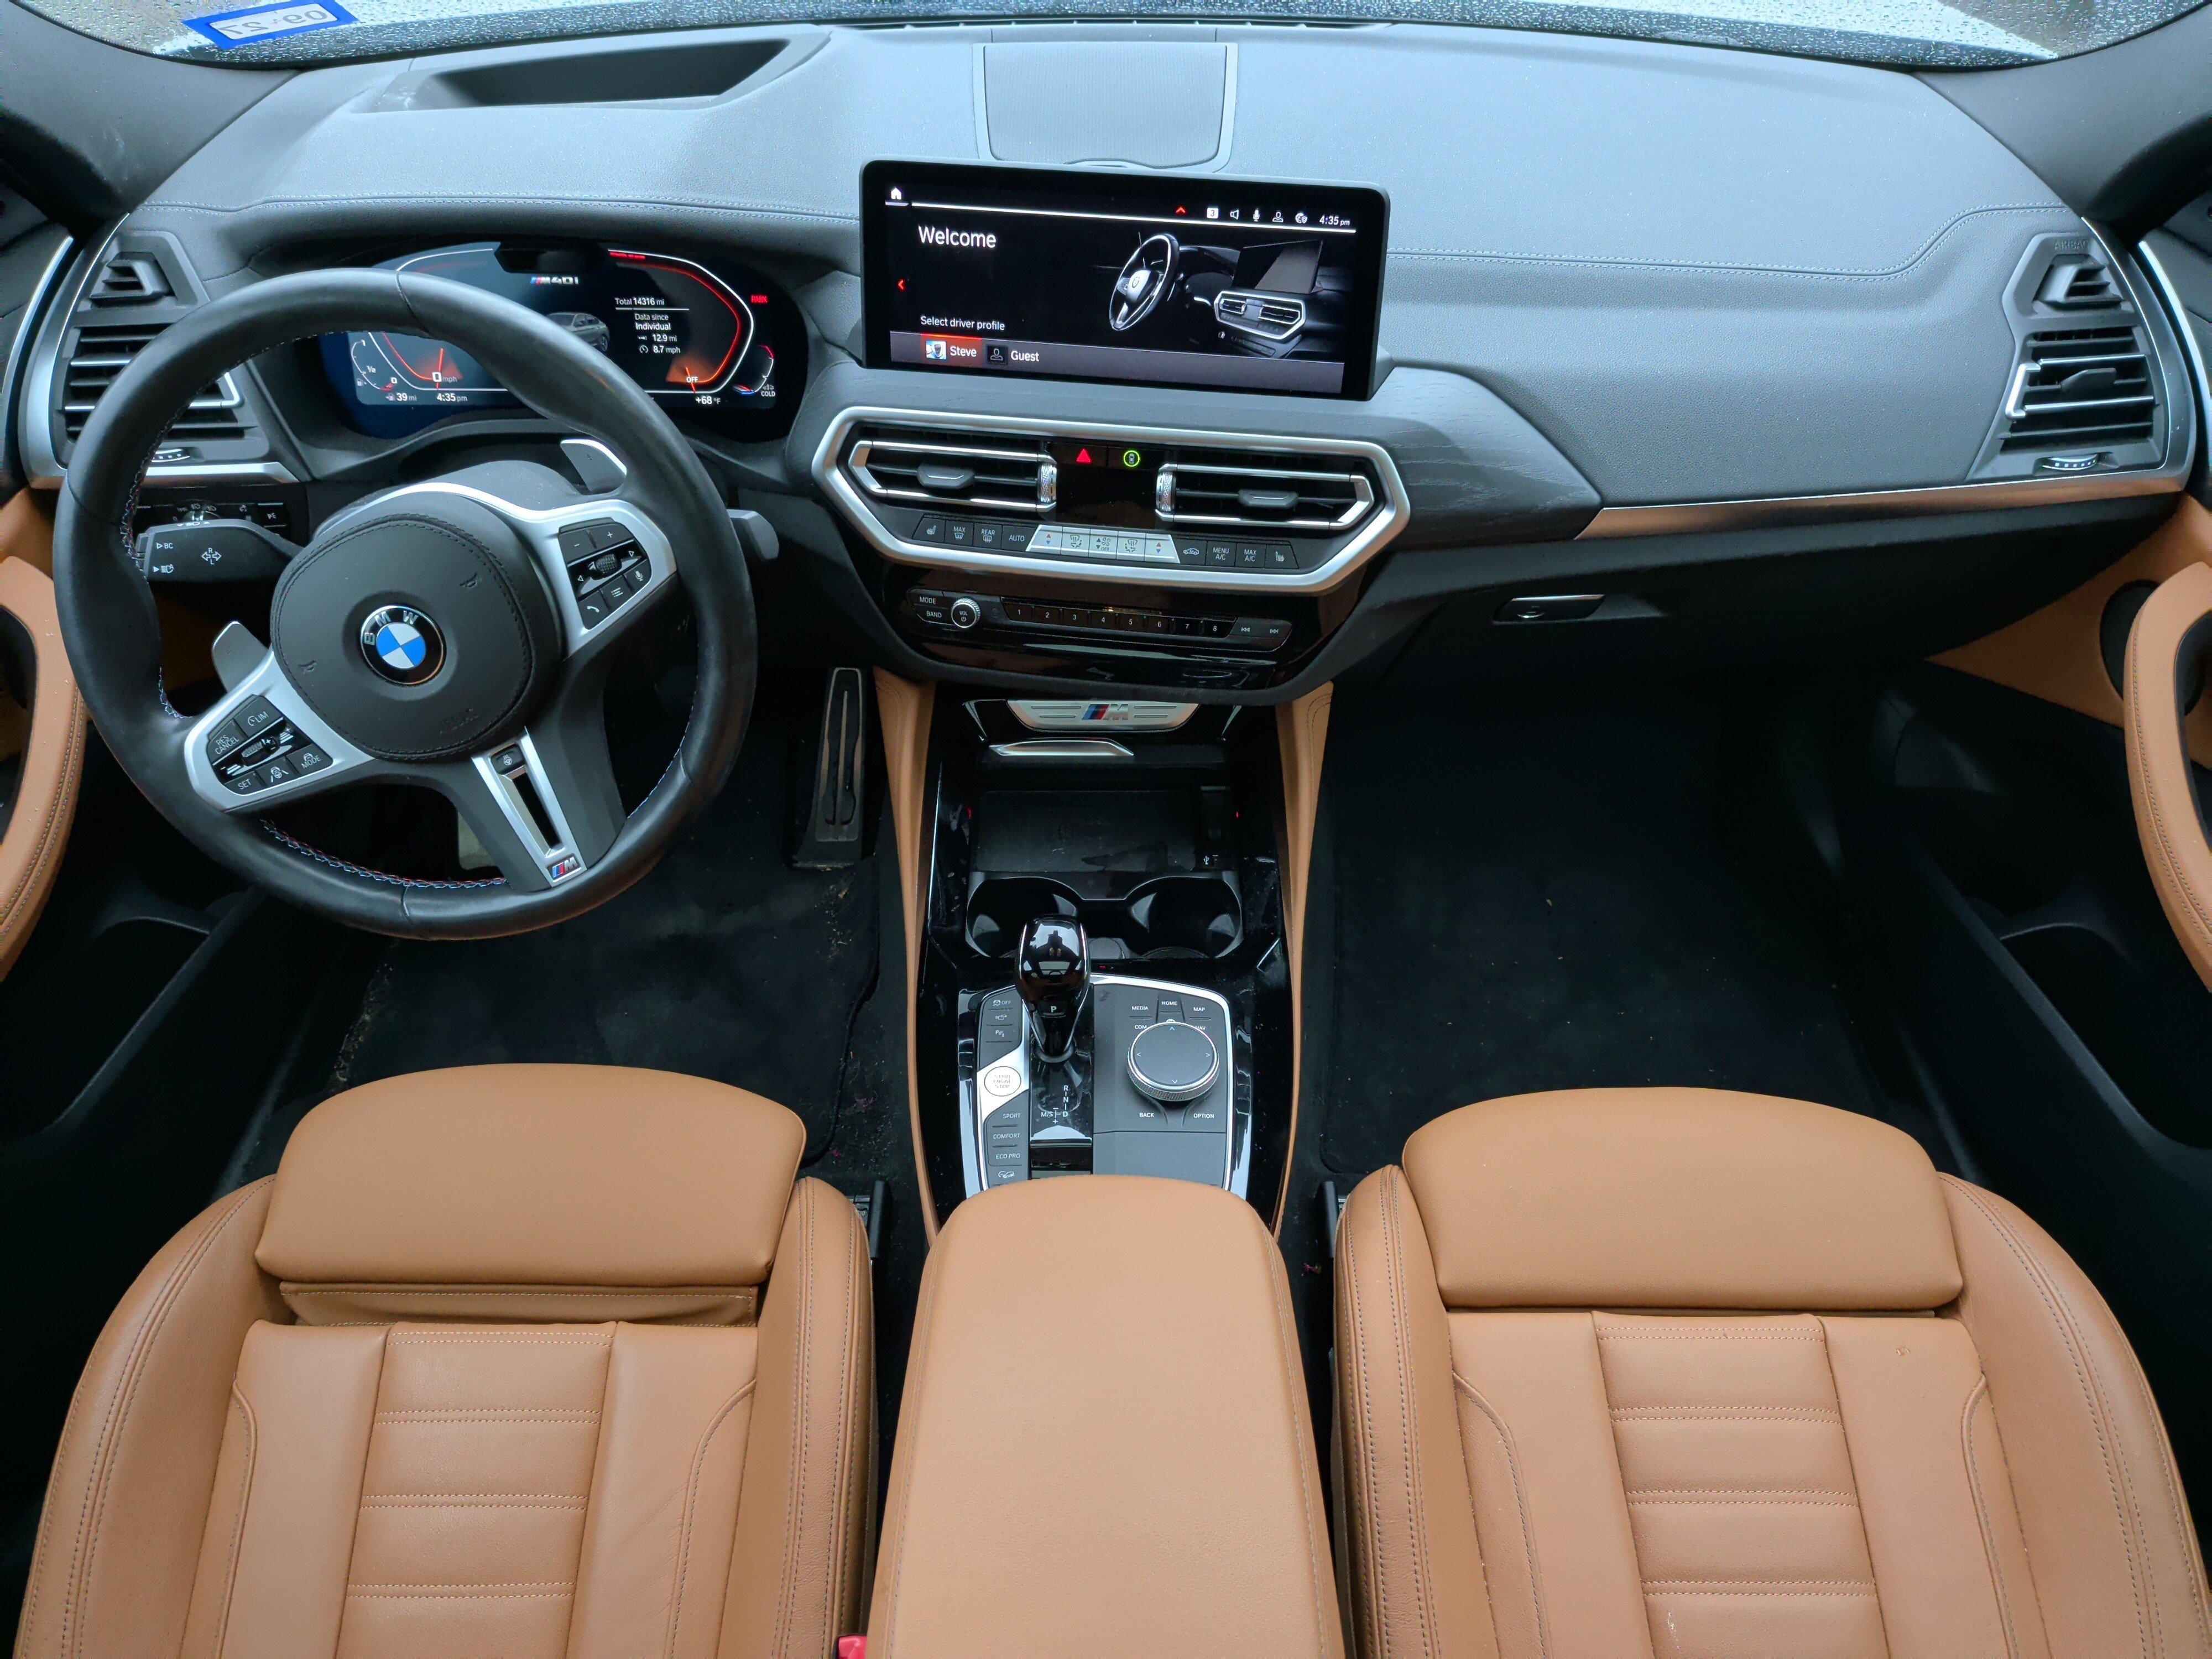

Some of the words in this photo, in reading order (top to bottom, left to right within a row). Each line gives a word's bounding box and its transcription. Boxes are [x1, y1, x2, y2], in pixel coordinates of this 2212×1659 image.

[1319, 215, 1339, 226] 4:35
[918, 225, 997, 248] Welcome
[920, 316, 948, 326] Select
[950, 318, 975, 328] driver
[977, 320, 1005, 331] profile
[950, 346, 977, 357] Steve
[1011, 350, 1039, 362] Guest
[432, 372, 442, 382] 0
[397, 393, 408, 401] 39
[437, 393, 456, 401] 4:35
[364, 611, 419, 645] BMW
[257, 711, 269, 723] LIM
[215, 736, 239, 755] CANCEL
[216, 735, 229, 745] RES
[301, 754, 321, 769] MODE
[238, 779, 252, 790] SET
